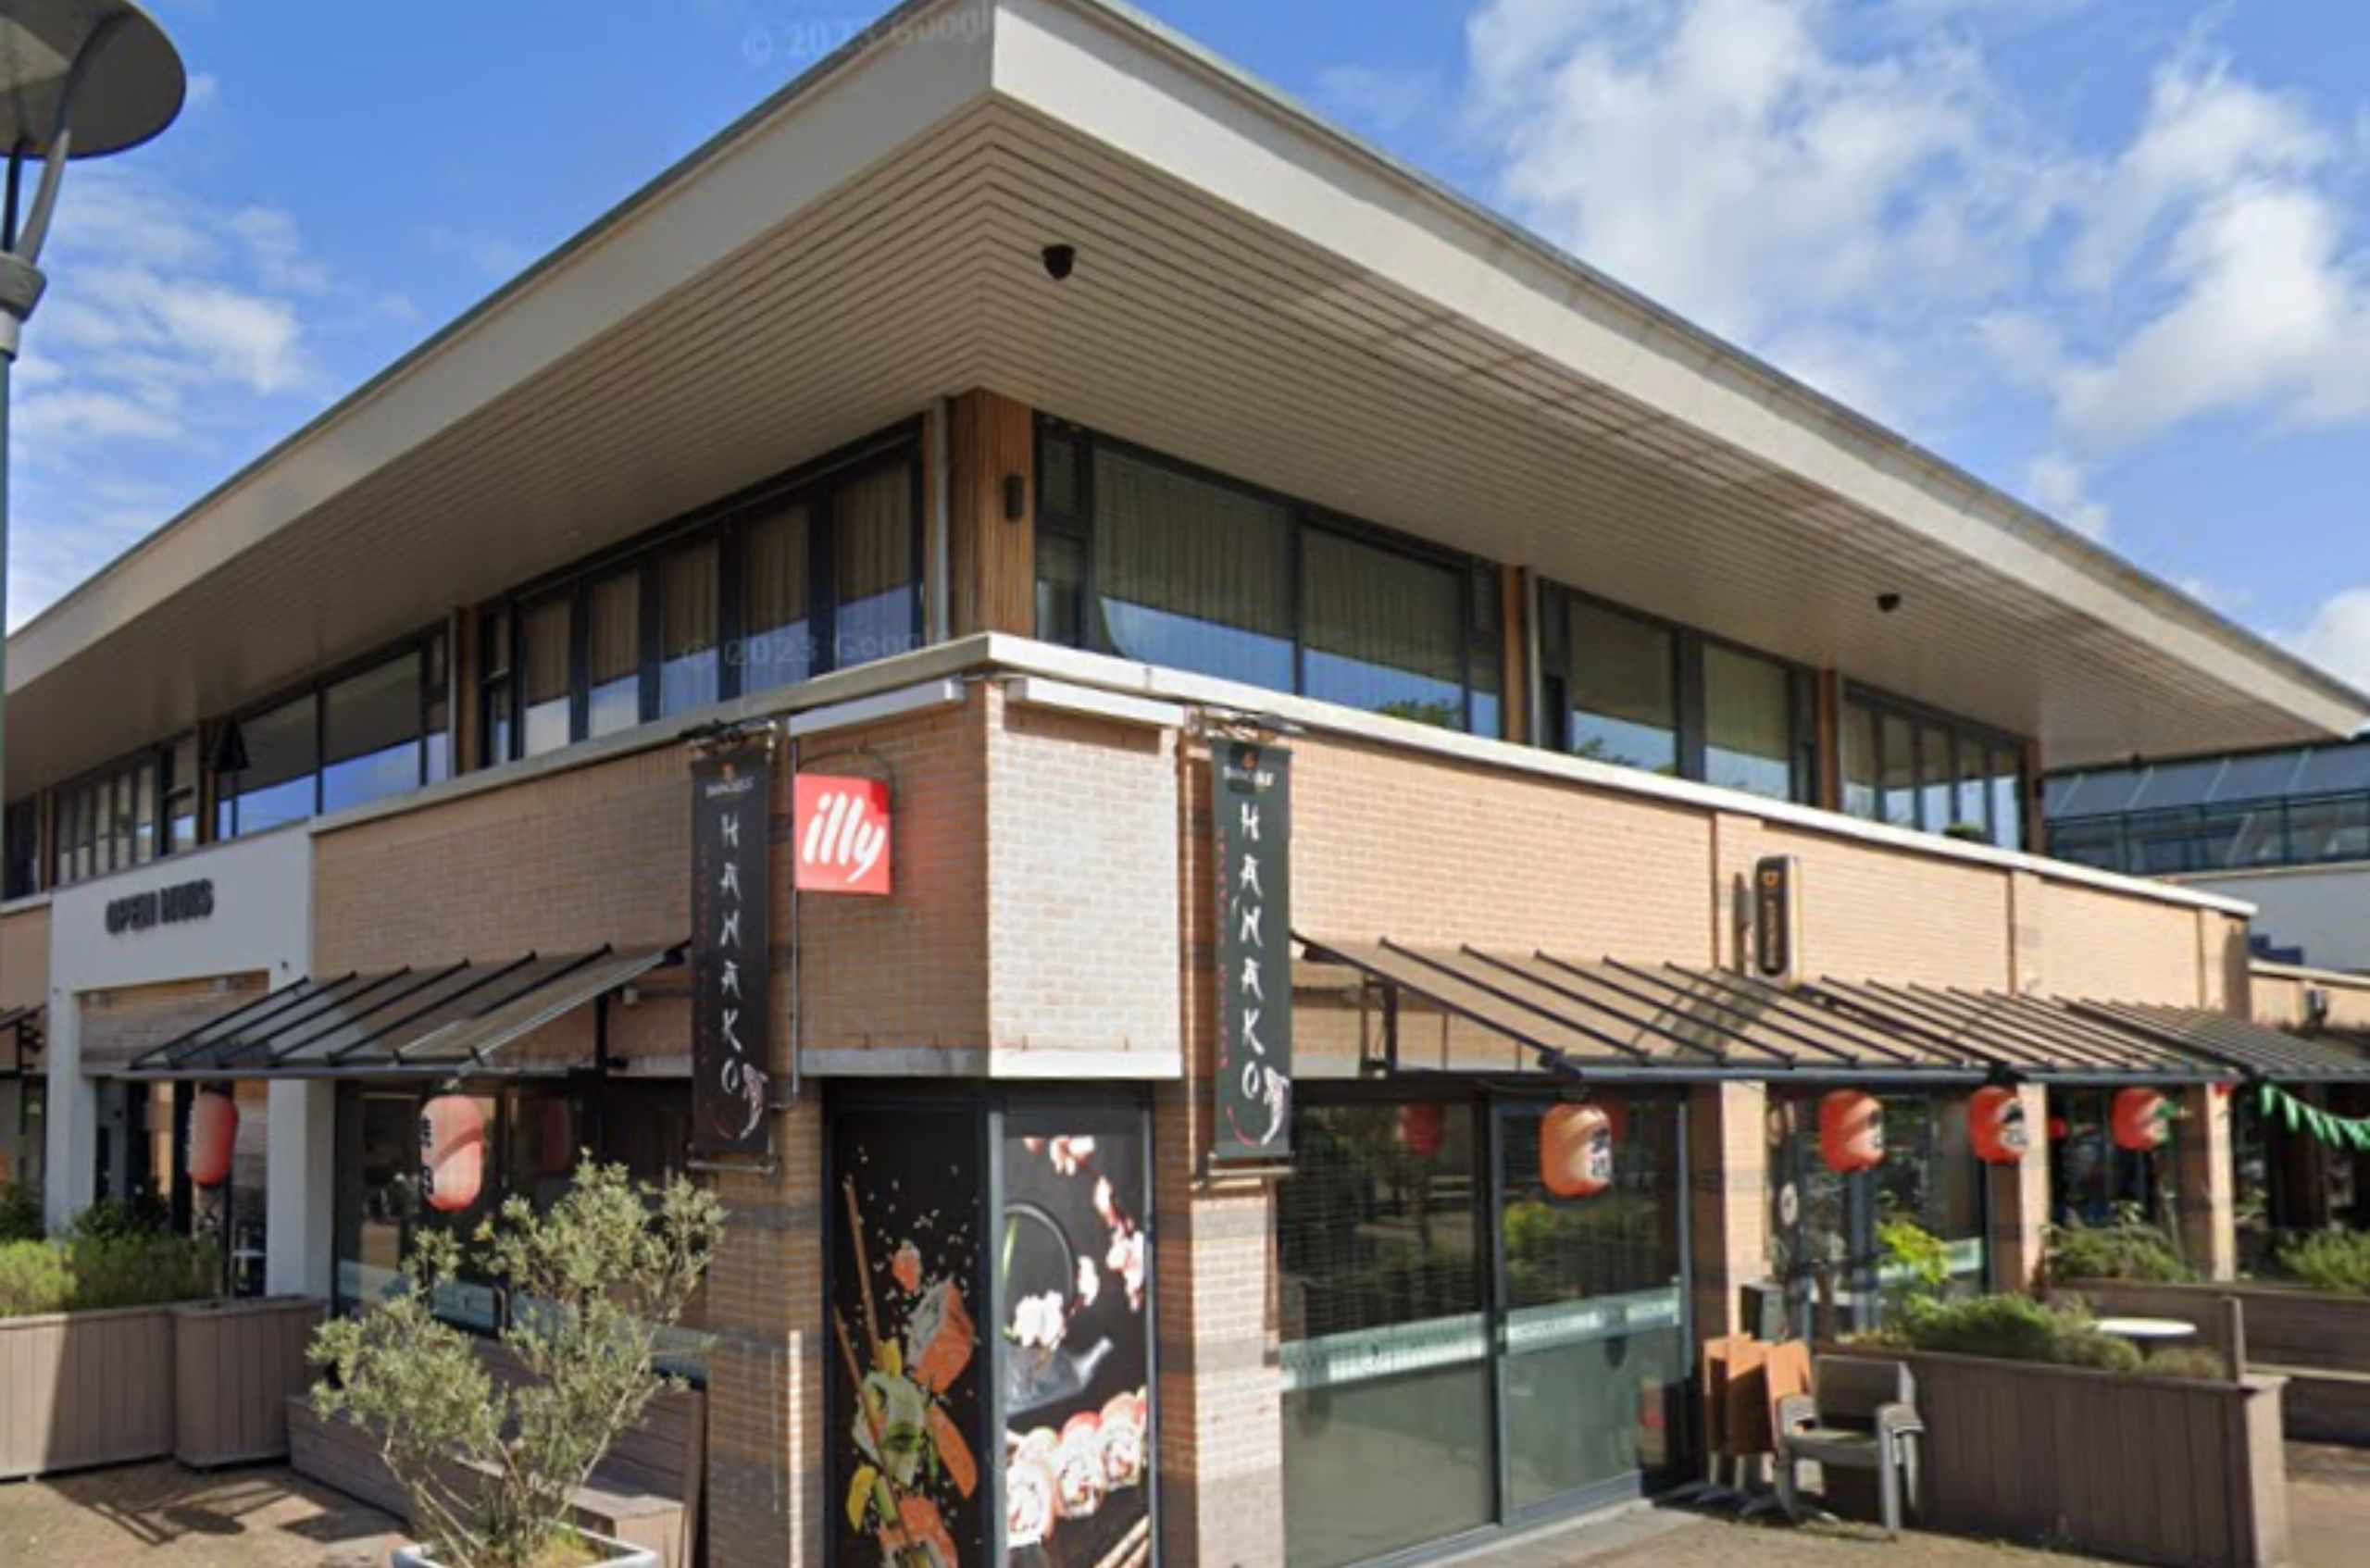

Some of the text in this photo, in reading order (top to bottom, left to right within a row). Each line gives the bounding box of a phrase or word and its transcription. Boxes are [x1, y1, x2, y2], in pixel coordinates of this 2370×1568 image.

[105, 890, 156, 935] OPEN
[803, 791, 887, 883] illy
[718, 812, 742, 1094] HANAKO
[1239, 801, 1266, 1099] HANAKO
